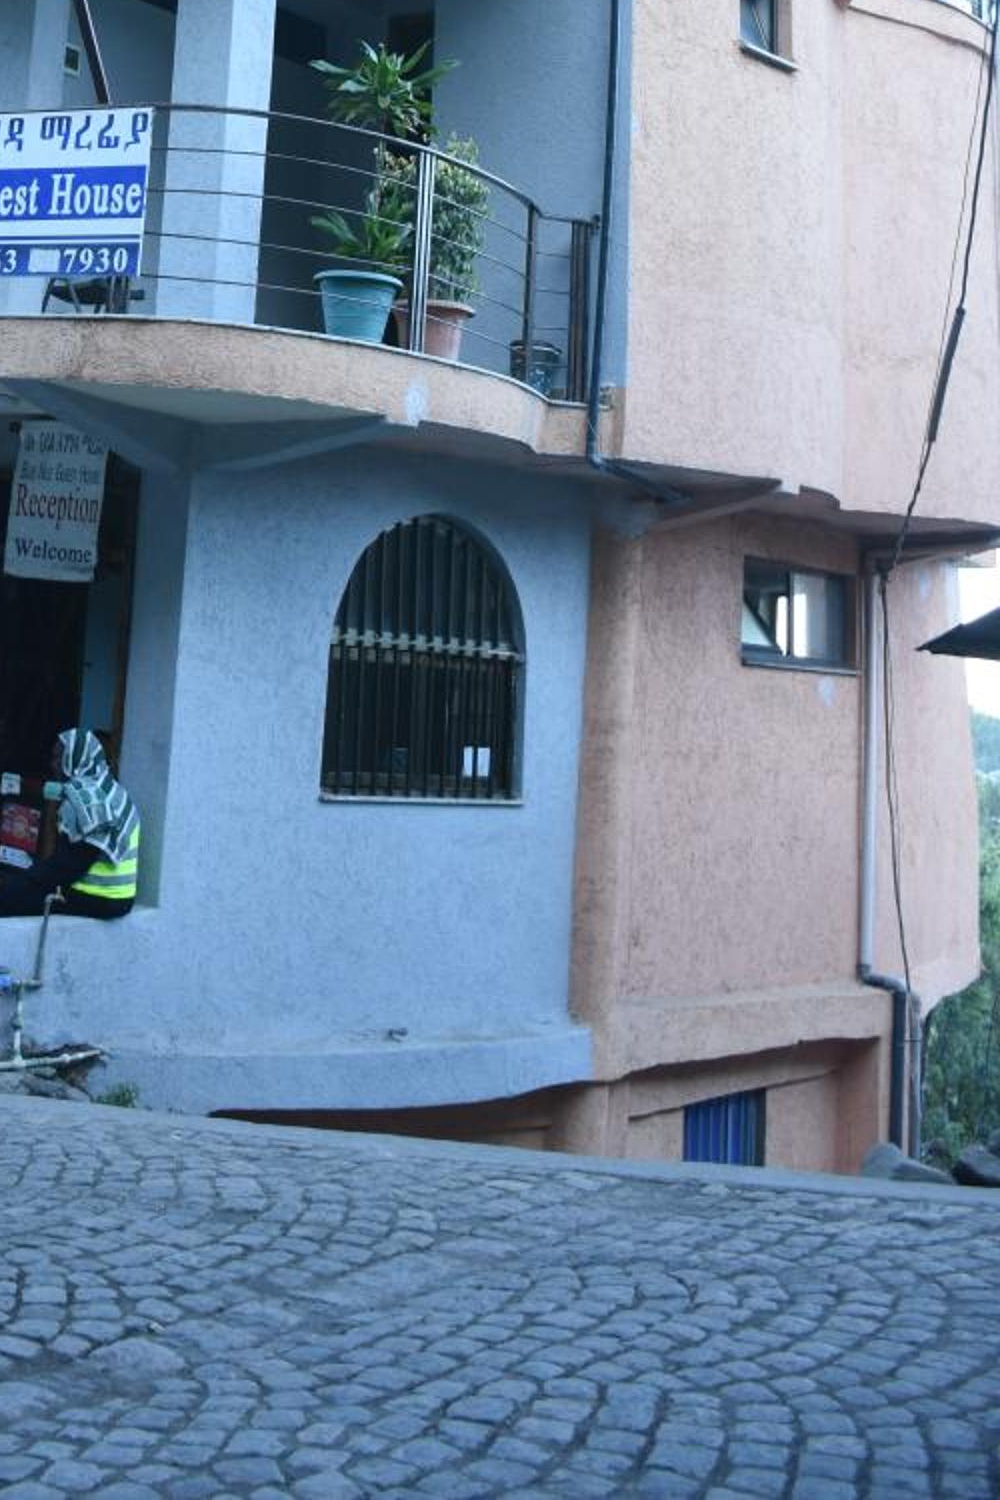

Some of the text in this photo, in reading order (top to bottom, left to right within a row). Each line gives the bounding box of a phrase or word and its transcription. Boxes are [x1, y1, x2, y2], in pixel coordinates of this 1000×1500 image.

[40, 112, 149, 151] ማረፊያ
[47, 173, 142, 215] House
[28, 248, 128, 273] 7930
[15, 483, 100, 530] Reception
[15, 537, 92, 563] Welcome
